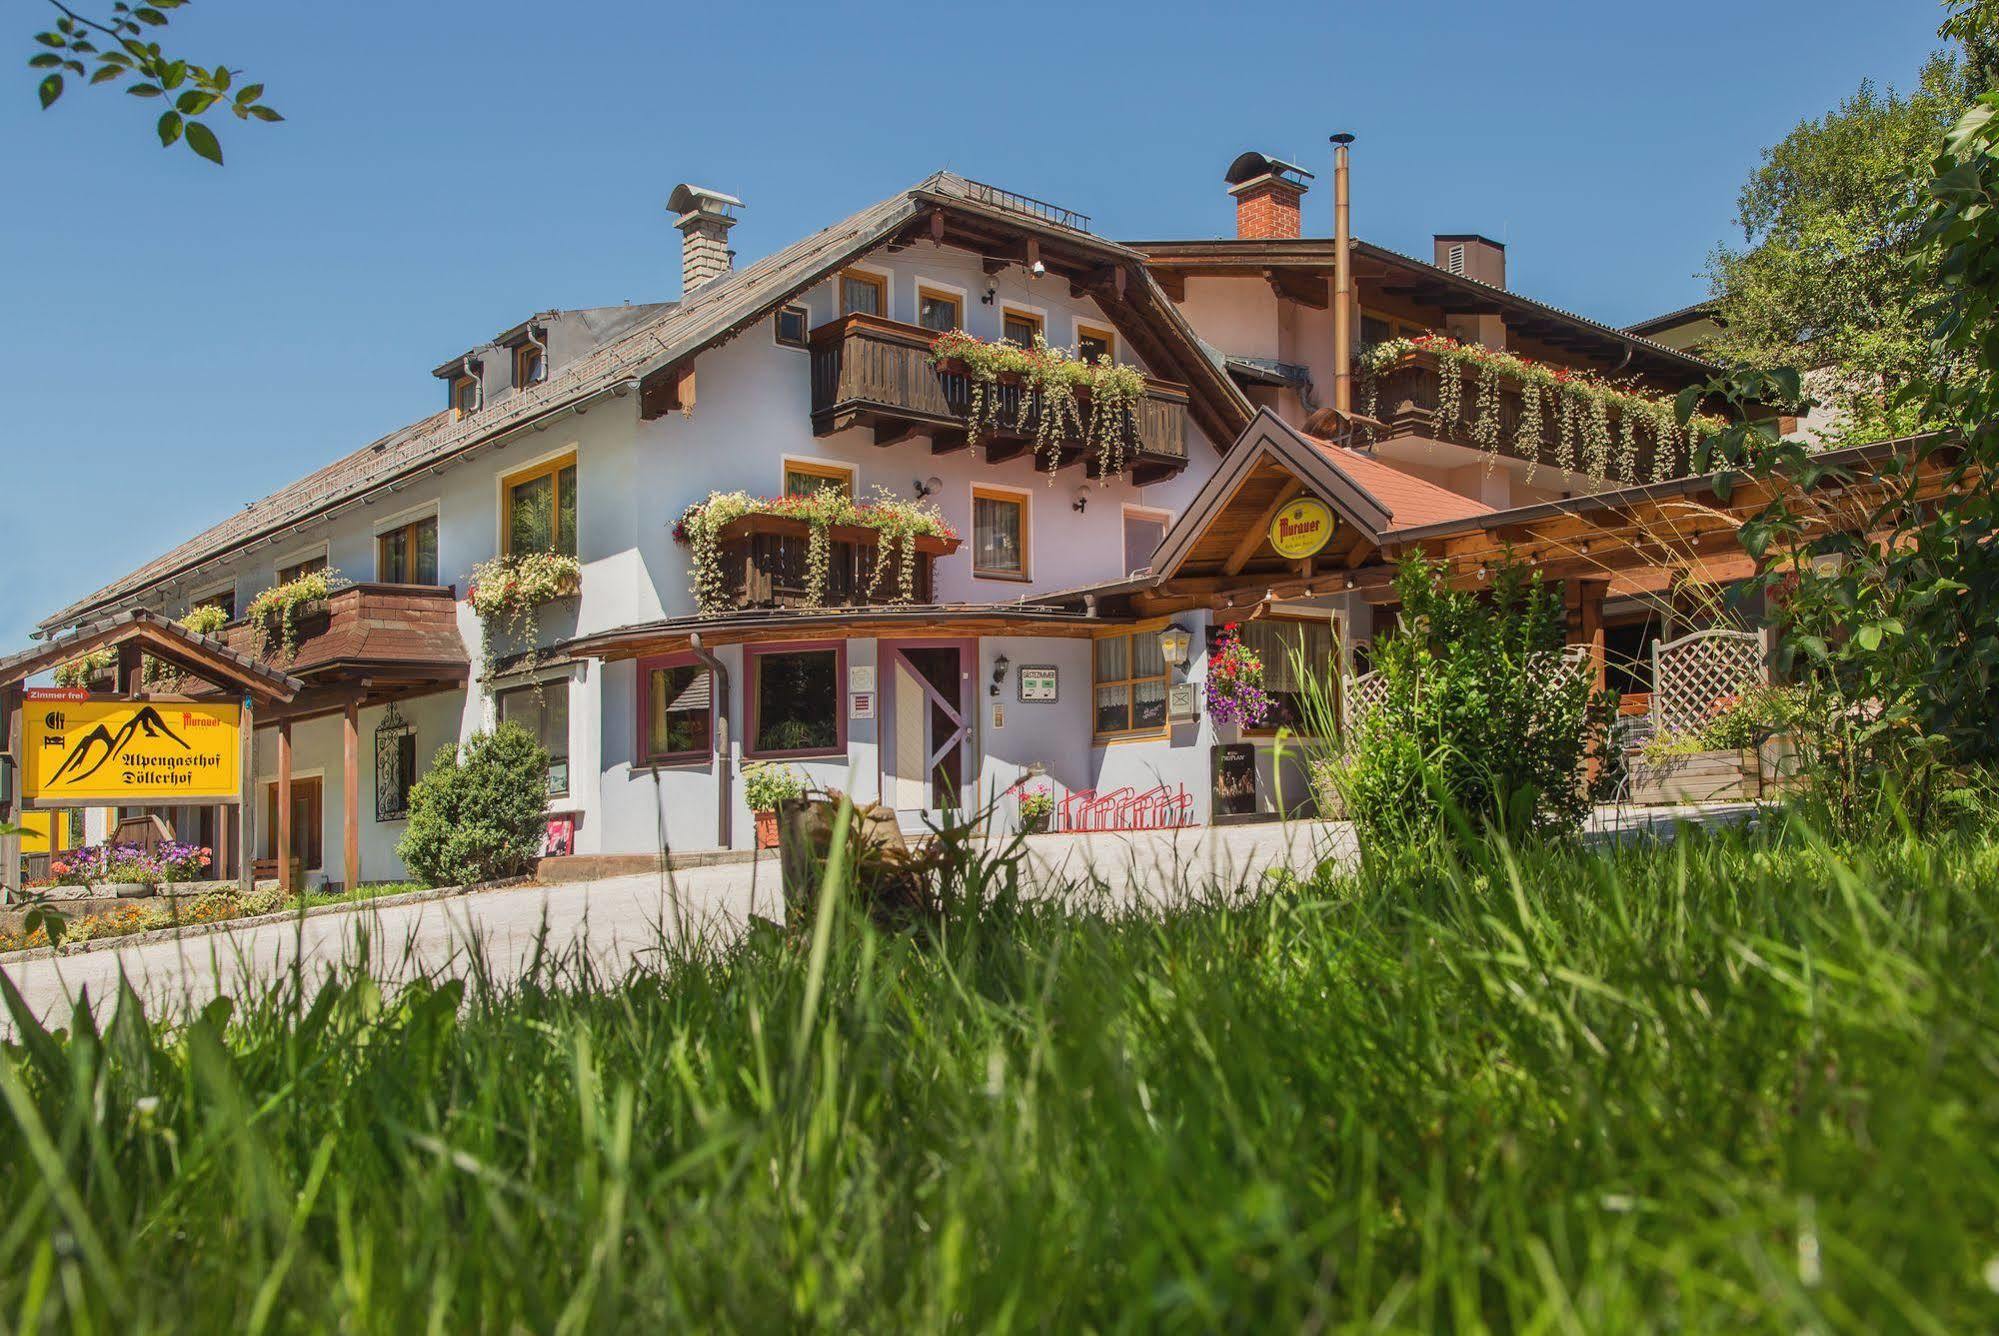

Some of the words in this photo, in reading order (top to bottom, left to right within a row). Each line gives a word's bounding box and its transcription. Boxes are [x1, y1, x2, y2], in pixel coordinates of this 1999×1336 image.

[1279, 517, 1321, 544] Murauer
[30, 691, 66, 699] Zimmer
[68, 691, 84, 700] frei
[183, 711, 221, 730] Murauer
[121, 753, 221, 769] Alpengasthof
[121, 770, 192, 787] Döllerhof
